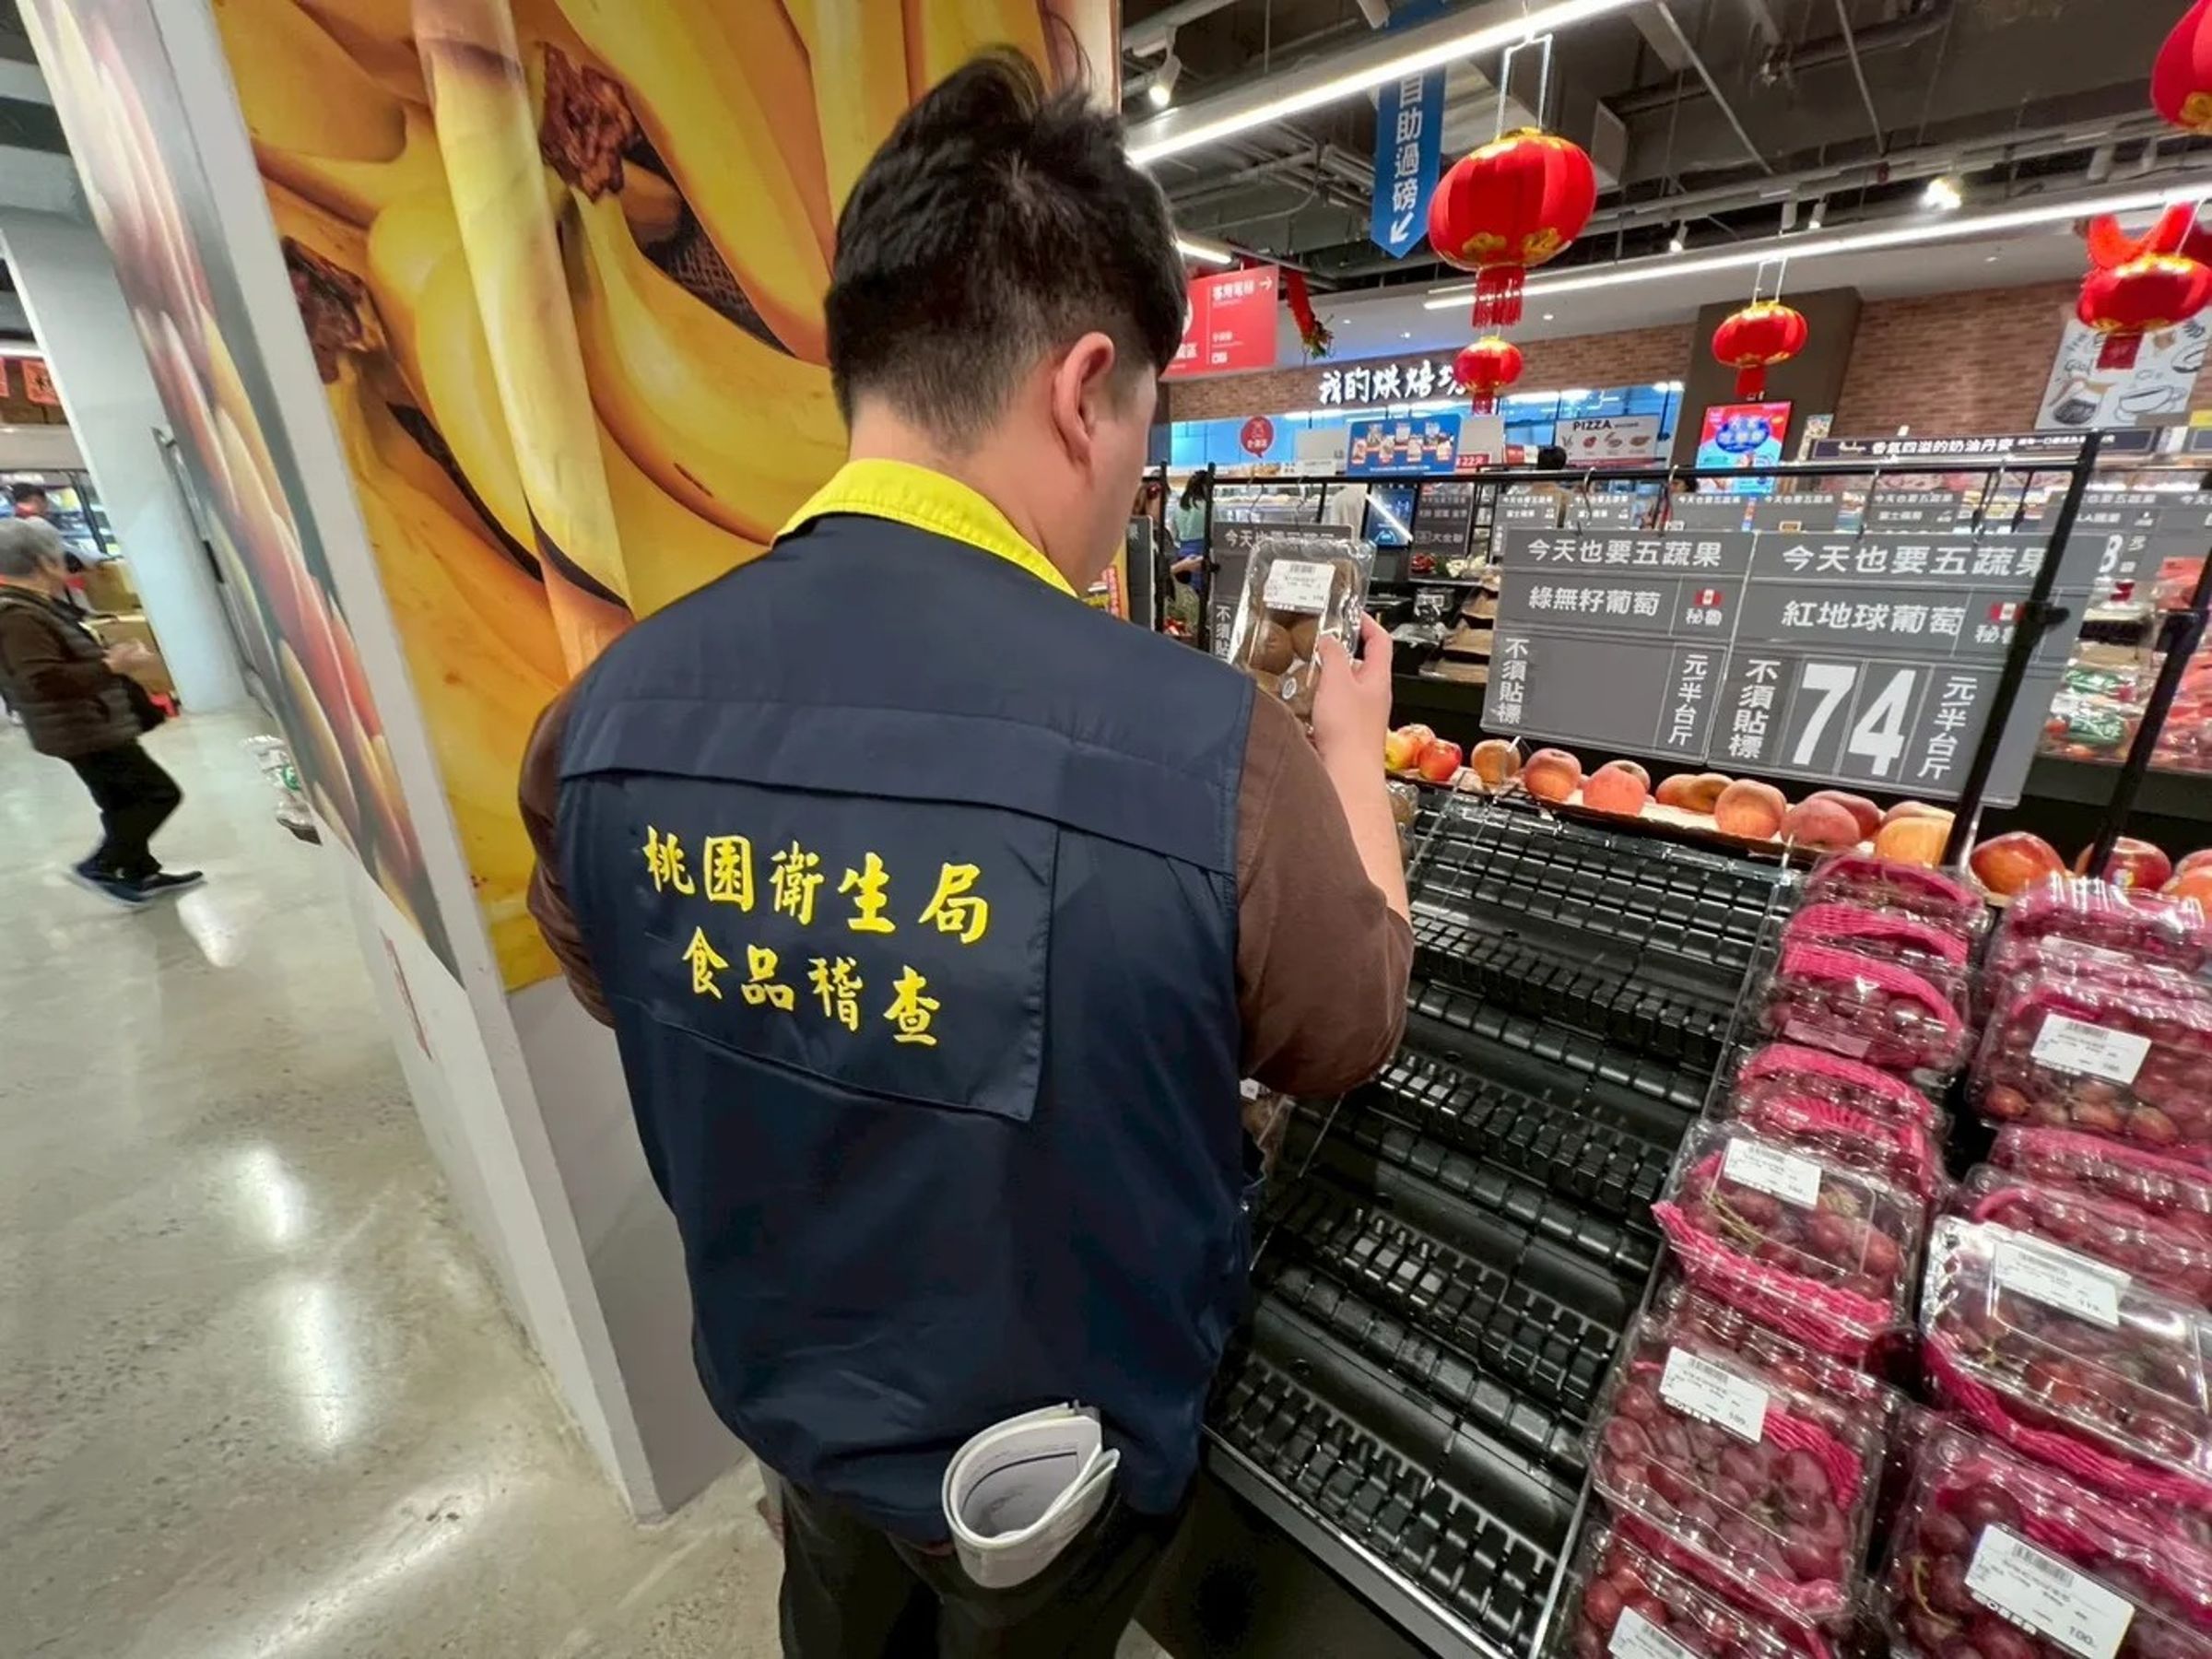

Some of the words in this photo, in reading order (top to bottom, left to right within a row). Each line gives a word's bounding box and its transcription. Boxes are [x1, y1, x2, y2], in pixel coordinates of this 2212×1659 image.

[1392, 72, 1423, 213] 自助過磅
[1572, 419, 1612, 430] PIZZA
[1526, 538, 1723, 568] 今天也要五蔬果
[1782, 545, 2047, 578] 今天也要五蔬果
[1528, 585, 1662, 617] 綠無籽葡萄
[1686, 607, 1724, 627] 秘魯
[1781, 600, 1966, 637] 紅地球葡萄
[1494, 637, 1530, 725] 不須貼標
[1726, 658, 1782, 759] 不須貼標
[1792, 662, 1917, 777] 74
[642, 825, 989, 945] 桃園衛生局
[681, 925, 941, 1047] 食品稽查
